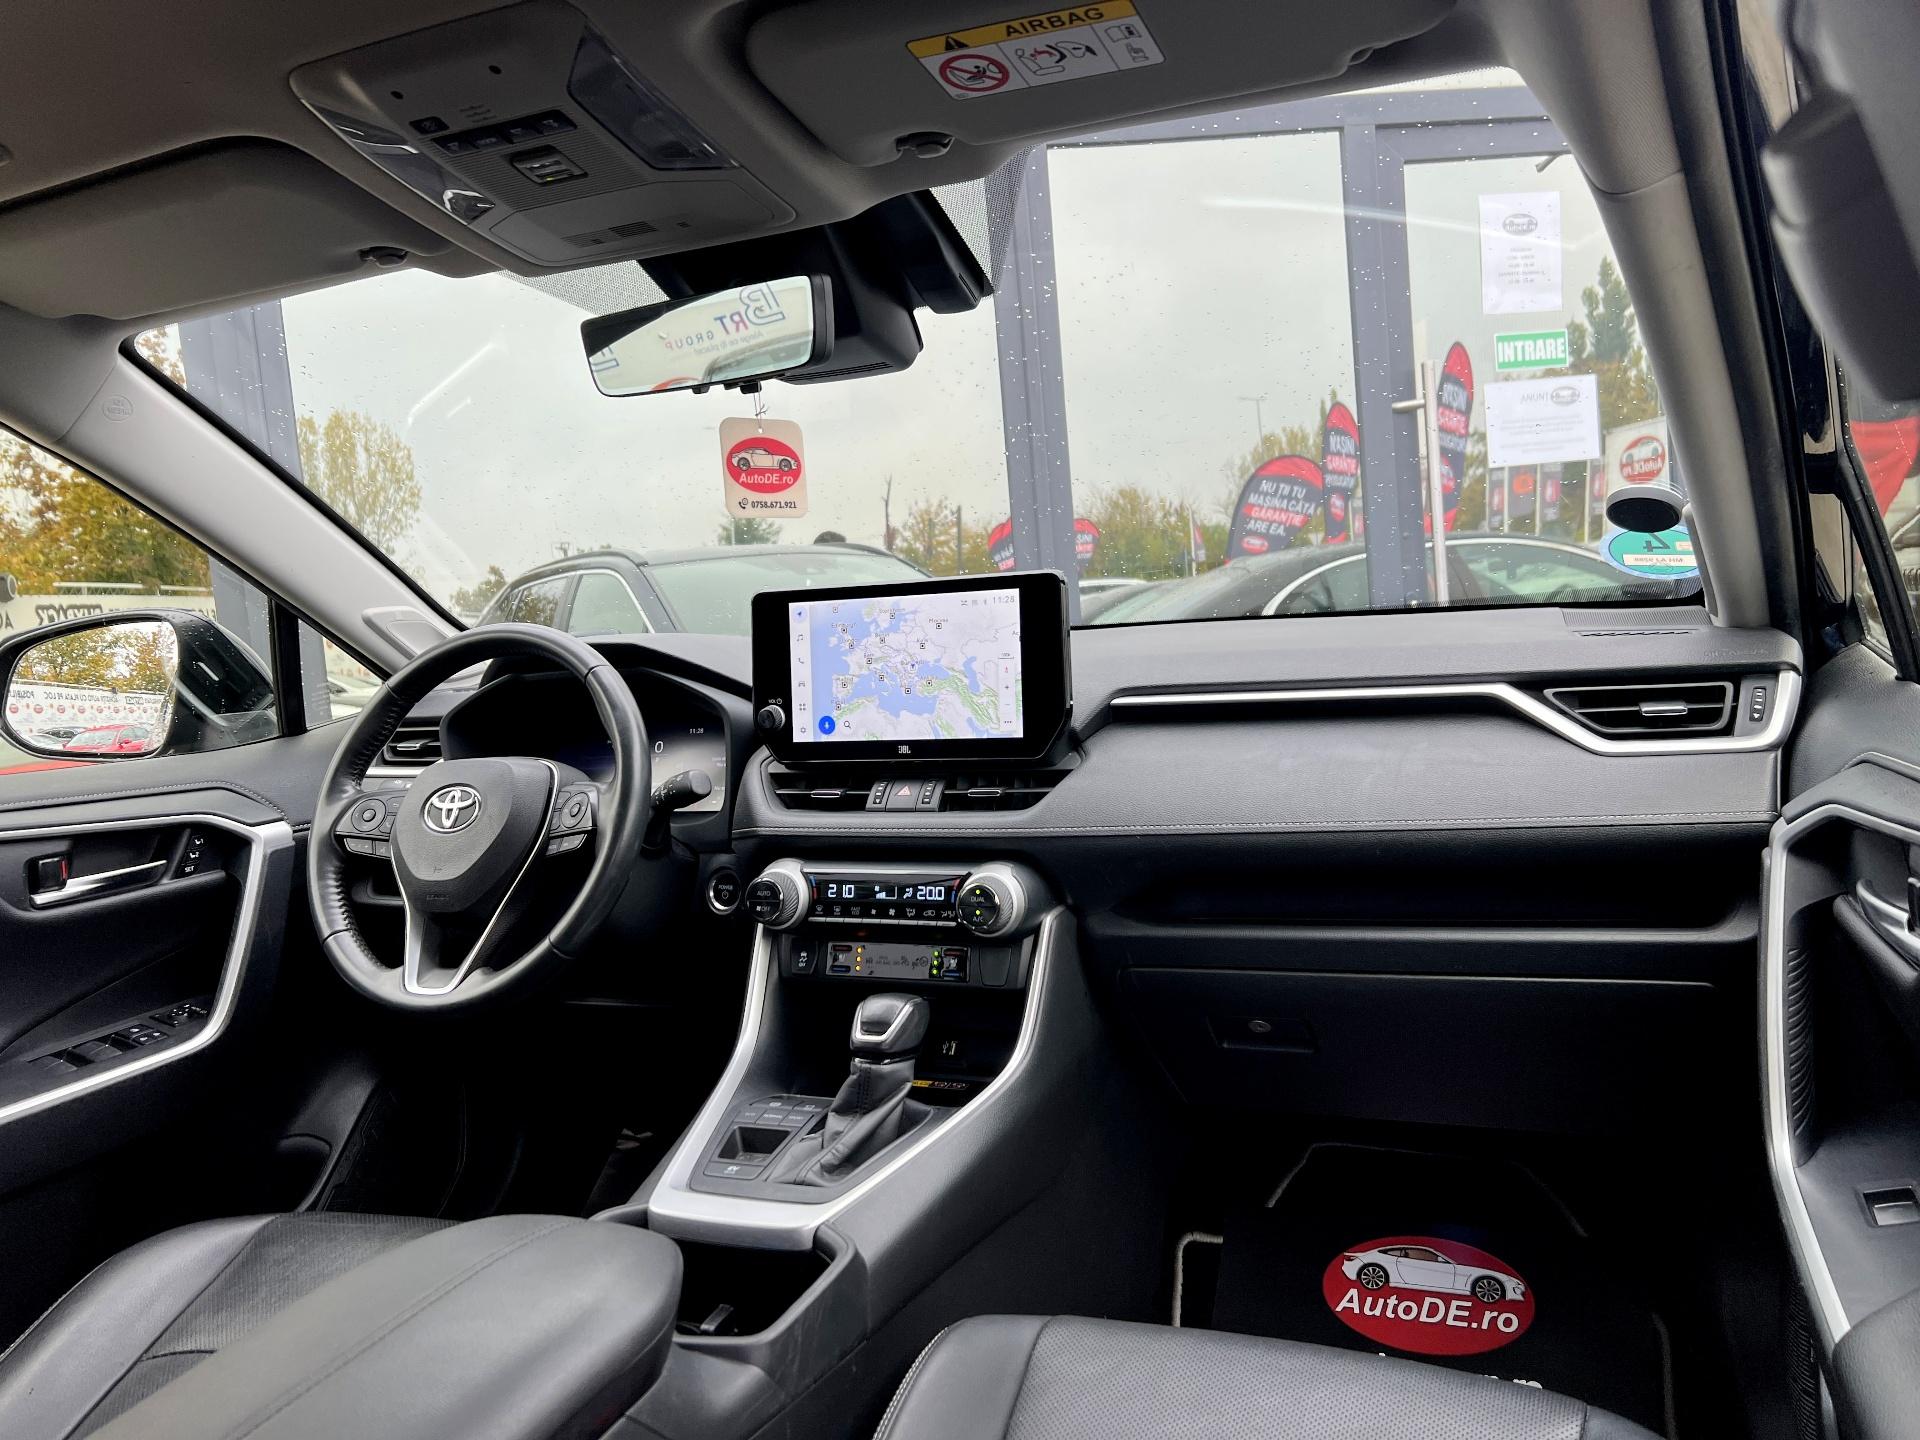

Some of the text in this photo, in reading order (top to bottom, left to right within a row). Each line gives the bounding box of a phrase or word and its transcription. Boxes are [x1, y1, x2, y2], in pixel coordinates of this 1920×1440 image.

[1006, 7, 1104, 37] AIRBAG
[1497, 337, 1565, 363] INTRARE
[739, 473, 794, 485] AutoDE.ro
[1291, 485, 1306, 499] TU
[751, 501, 797, 509] 0758.671.921
[1247, 520, 1269, 532] ARE
[992, 596, 1015, 605] 11:28
[654, 740, 664, 753] 0
[898, 745, 911, 754] JBL
[1335, 1287, 1520, 1334] AutoDE.ro
